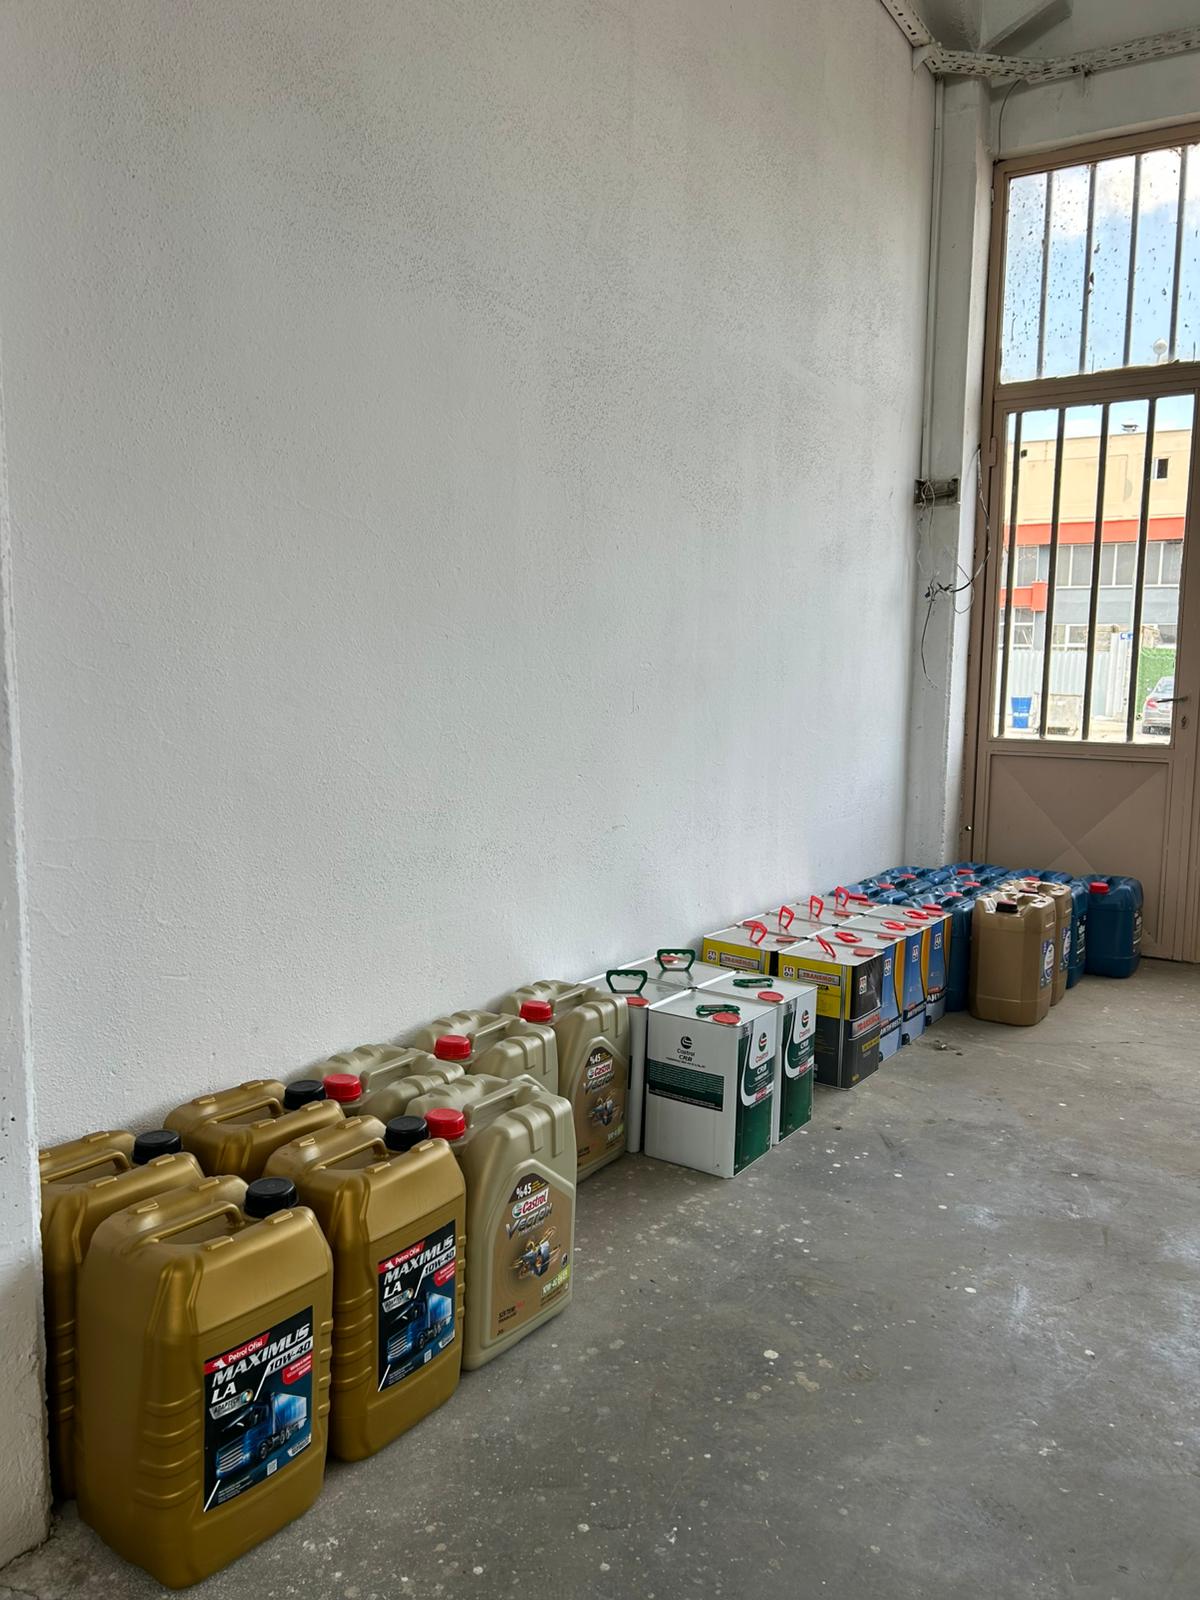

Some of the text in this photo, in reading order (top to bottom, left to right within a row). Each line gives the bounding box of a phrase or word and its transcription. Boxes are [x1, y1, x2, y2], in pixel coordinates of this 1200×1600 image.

[516, 1182, 532, 1199] %45
[522, 1194, 547, 1214] Castrol
[384, 1234, 454, 1285] MAXIMUS
[395, 1254, 409, 1265] Petrol
[384, 1281, 402, 1299] LA
[212, 1323, 310, 1388] MAXIMUS
[228, 1338, 263, 1363] Petrol Ofisi
[269, 1340, 311, 1371] 10W-40
[211, 1381, 237, 1404] LA
